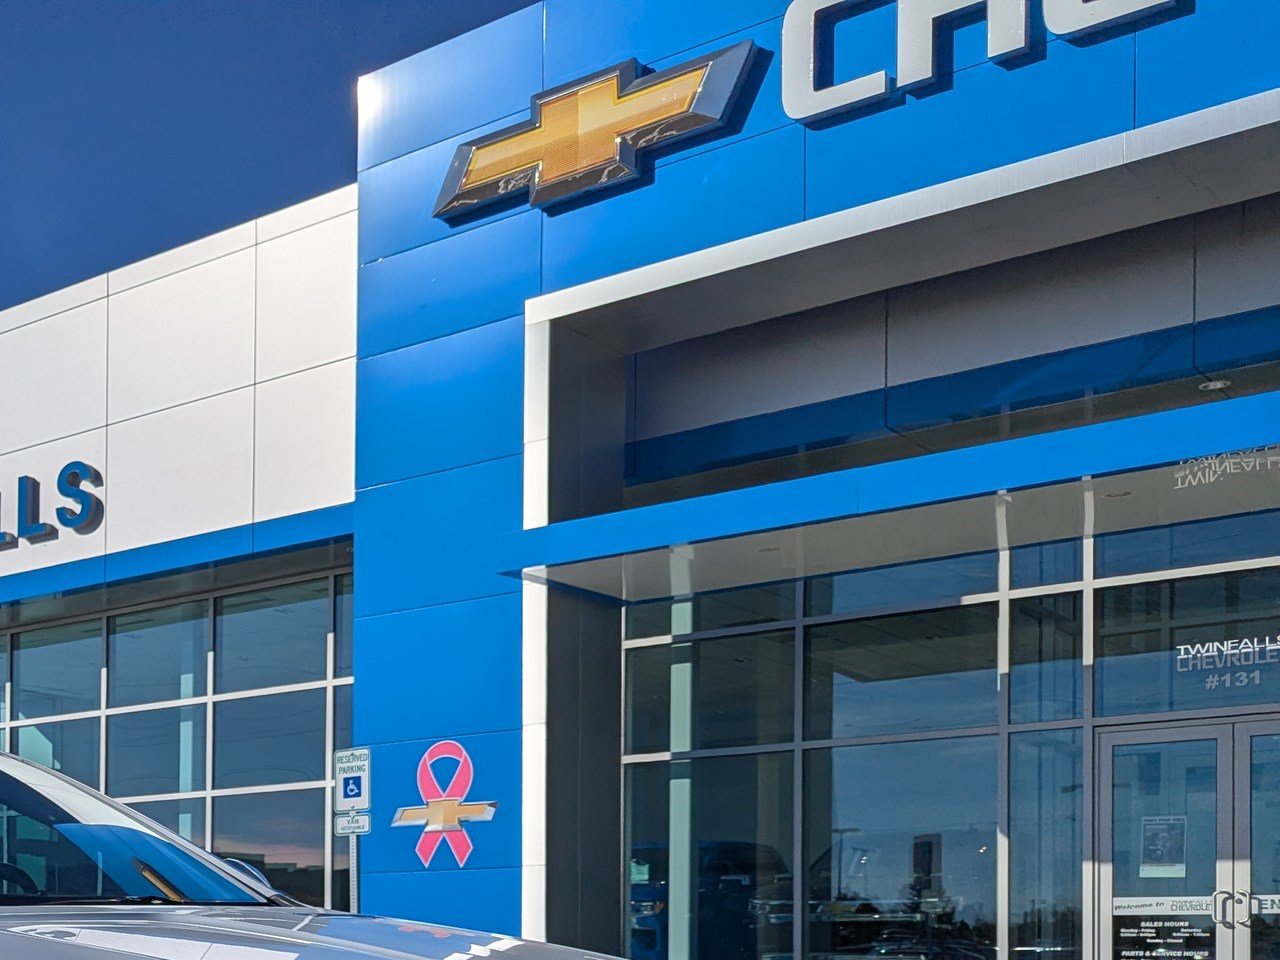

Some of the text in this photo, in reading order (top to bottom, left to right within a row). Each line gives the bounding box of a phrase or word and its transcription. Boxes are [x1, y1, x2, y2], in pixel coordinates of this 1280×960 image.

[1176, 647, 1280, 672] CHEVROLE
[1205, 669, 1260, 690] #131
[336, 753, 368, 764] RESERVED
[339, 764, 366, 774] PARKING
[1114, 903, 1153, 911] Welcome
